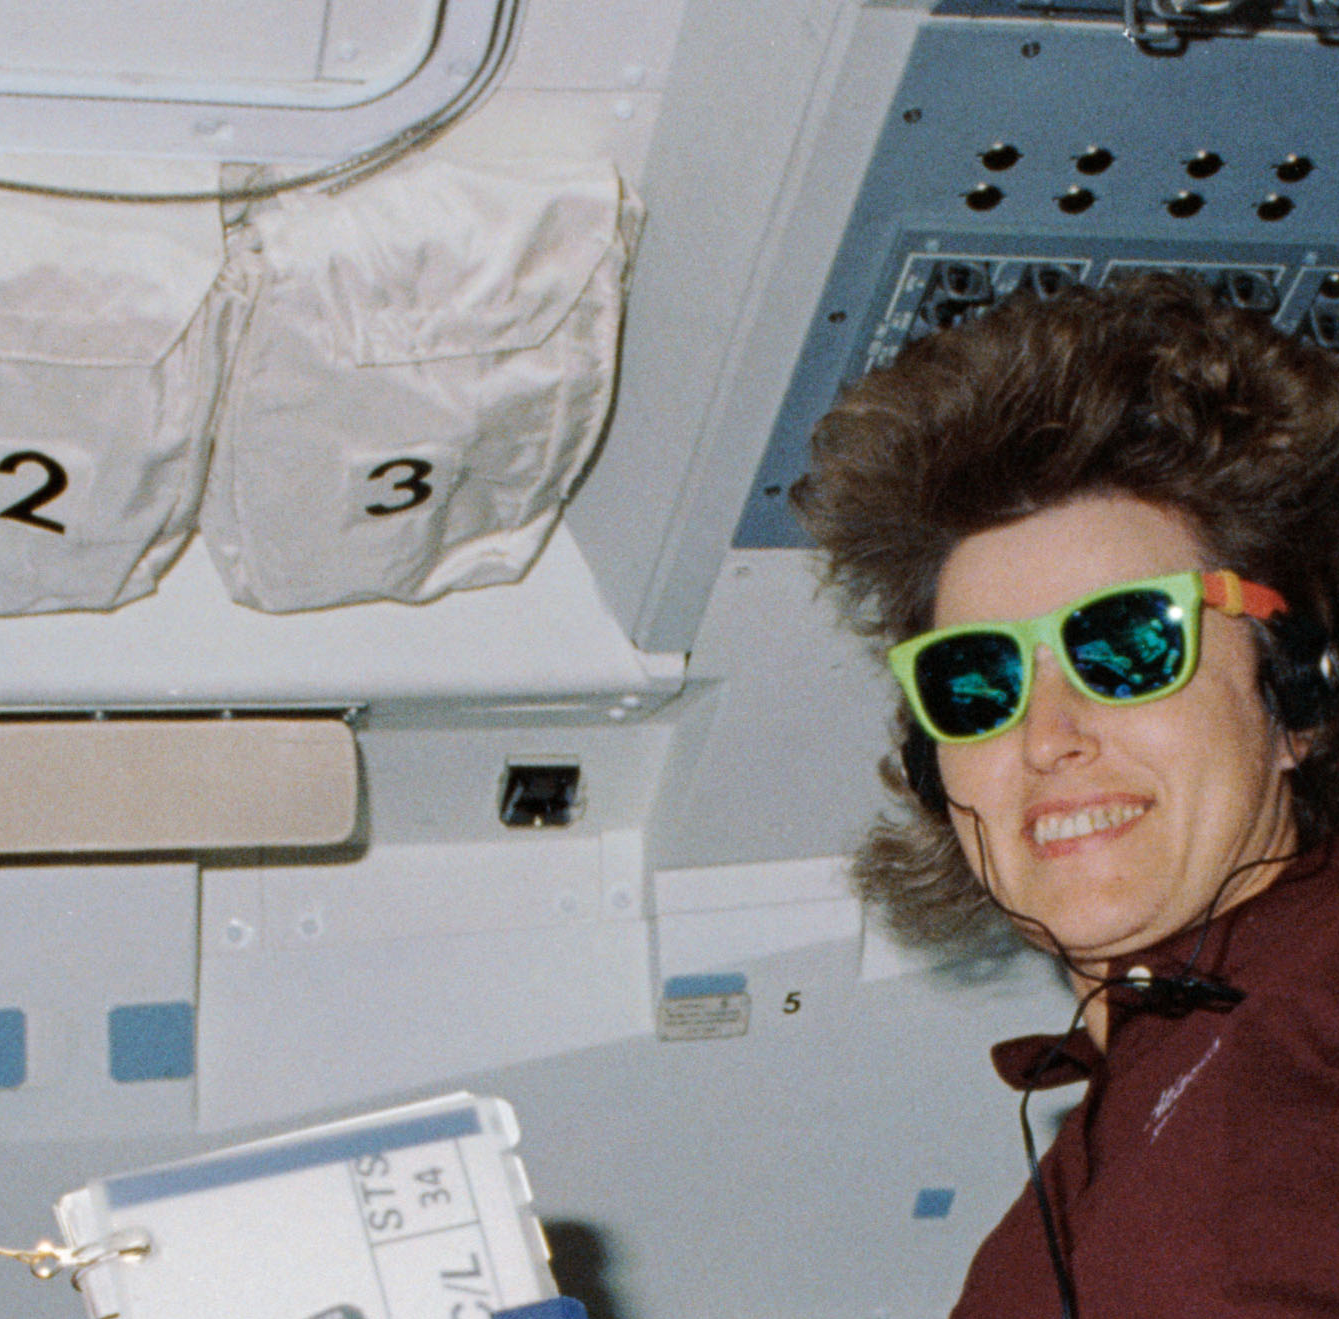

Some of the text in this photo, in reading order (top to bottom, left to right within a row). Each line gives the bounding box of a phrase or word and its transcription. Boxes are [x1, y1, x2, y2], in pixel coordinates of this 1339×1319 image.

[365, 457, 434, 515] 3
[782, 991, 802, 1014] 5
[356, 1155, 404, 1232] STS
[414, 1167, 452, 1208] 34
